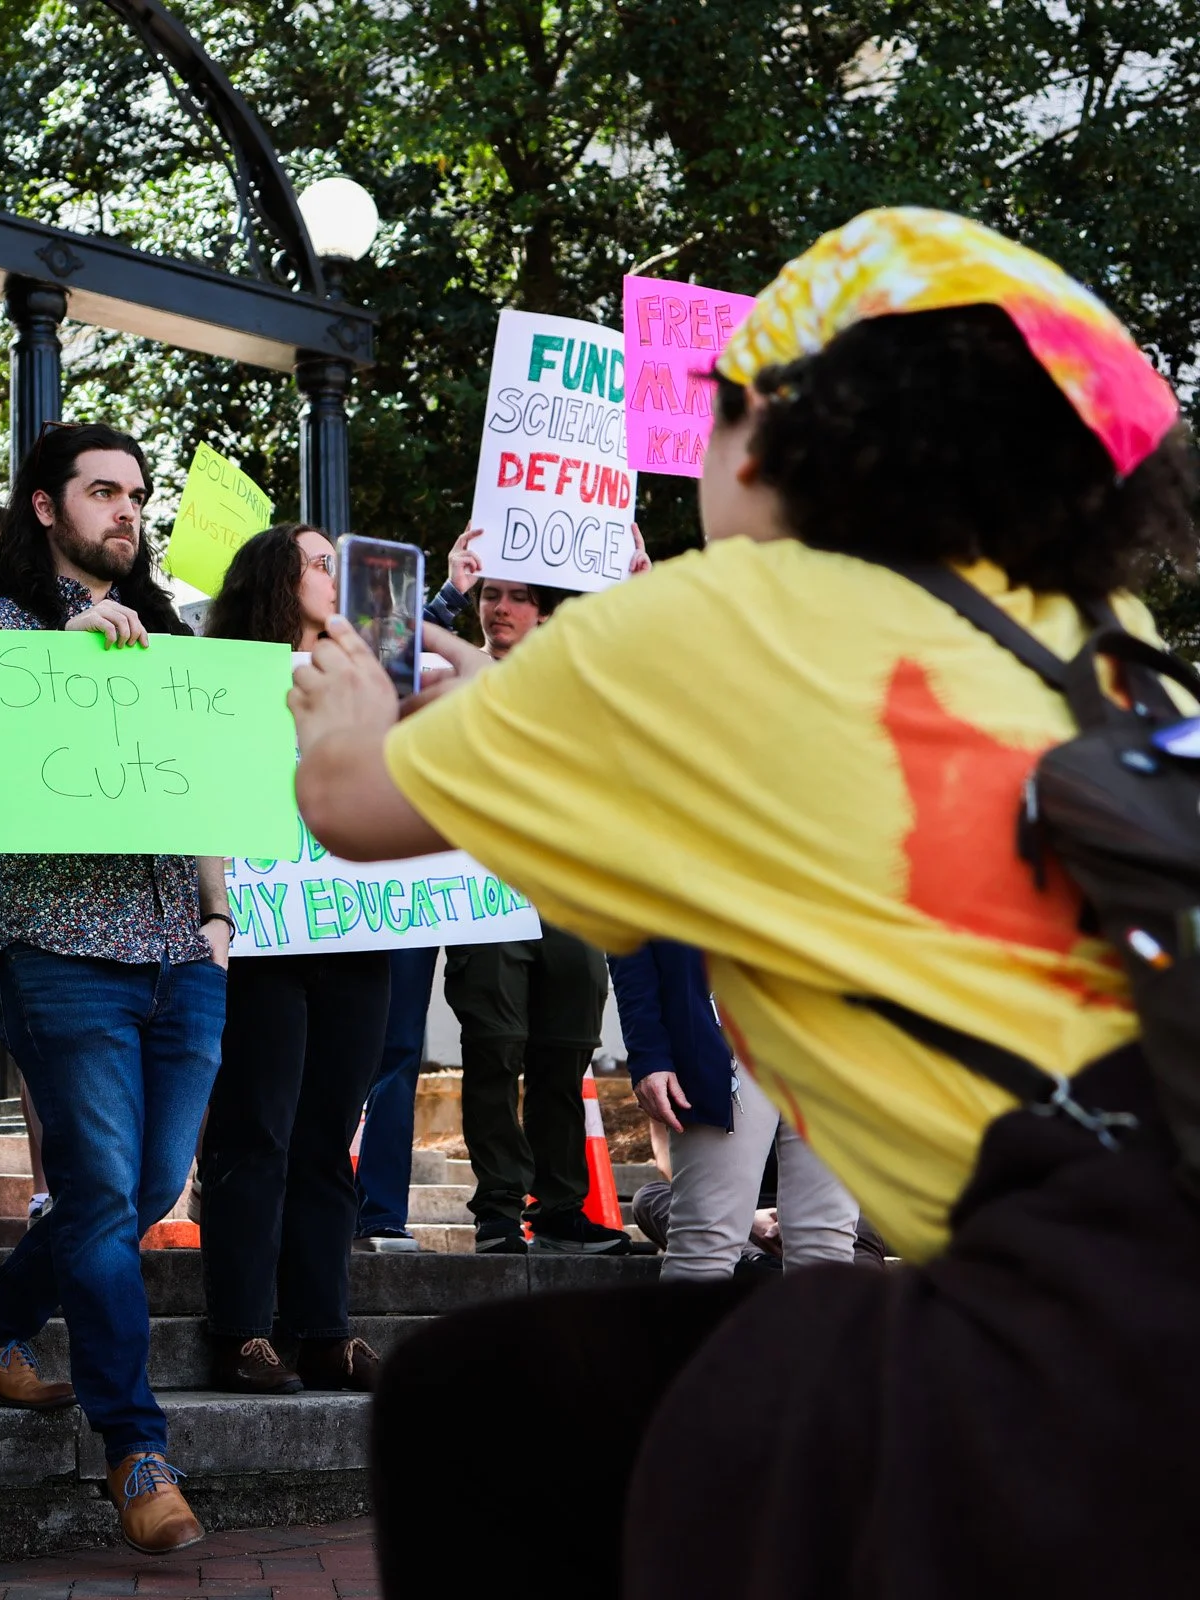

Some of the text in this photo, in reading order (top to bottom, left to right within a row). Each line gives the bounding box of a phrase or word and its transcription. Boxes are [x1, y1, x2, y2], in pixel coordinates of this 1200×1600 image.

[636, 295, 734, 351] FREE
[527, 334, 625, 403] FUND
[630, 360, 714, 418] MA
[196, 450, 270, 528] SOLIDARITY
[497, 451, 631, 510] DEFUND
[501, 507, 625, 580] DOGE
[161, 666, 235, 716] the
[40, 741, 190, 800] Cuts
[226, 881, 290, 948] MY
